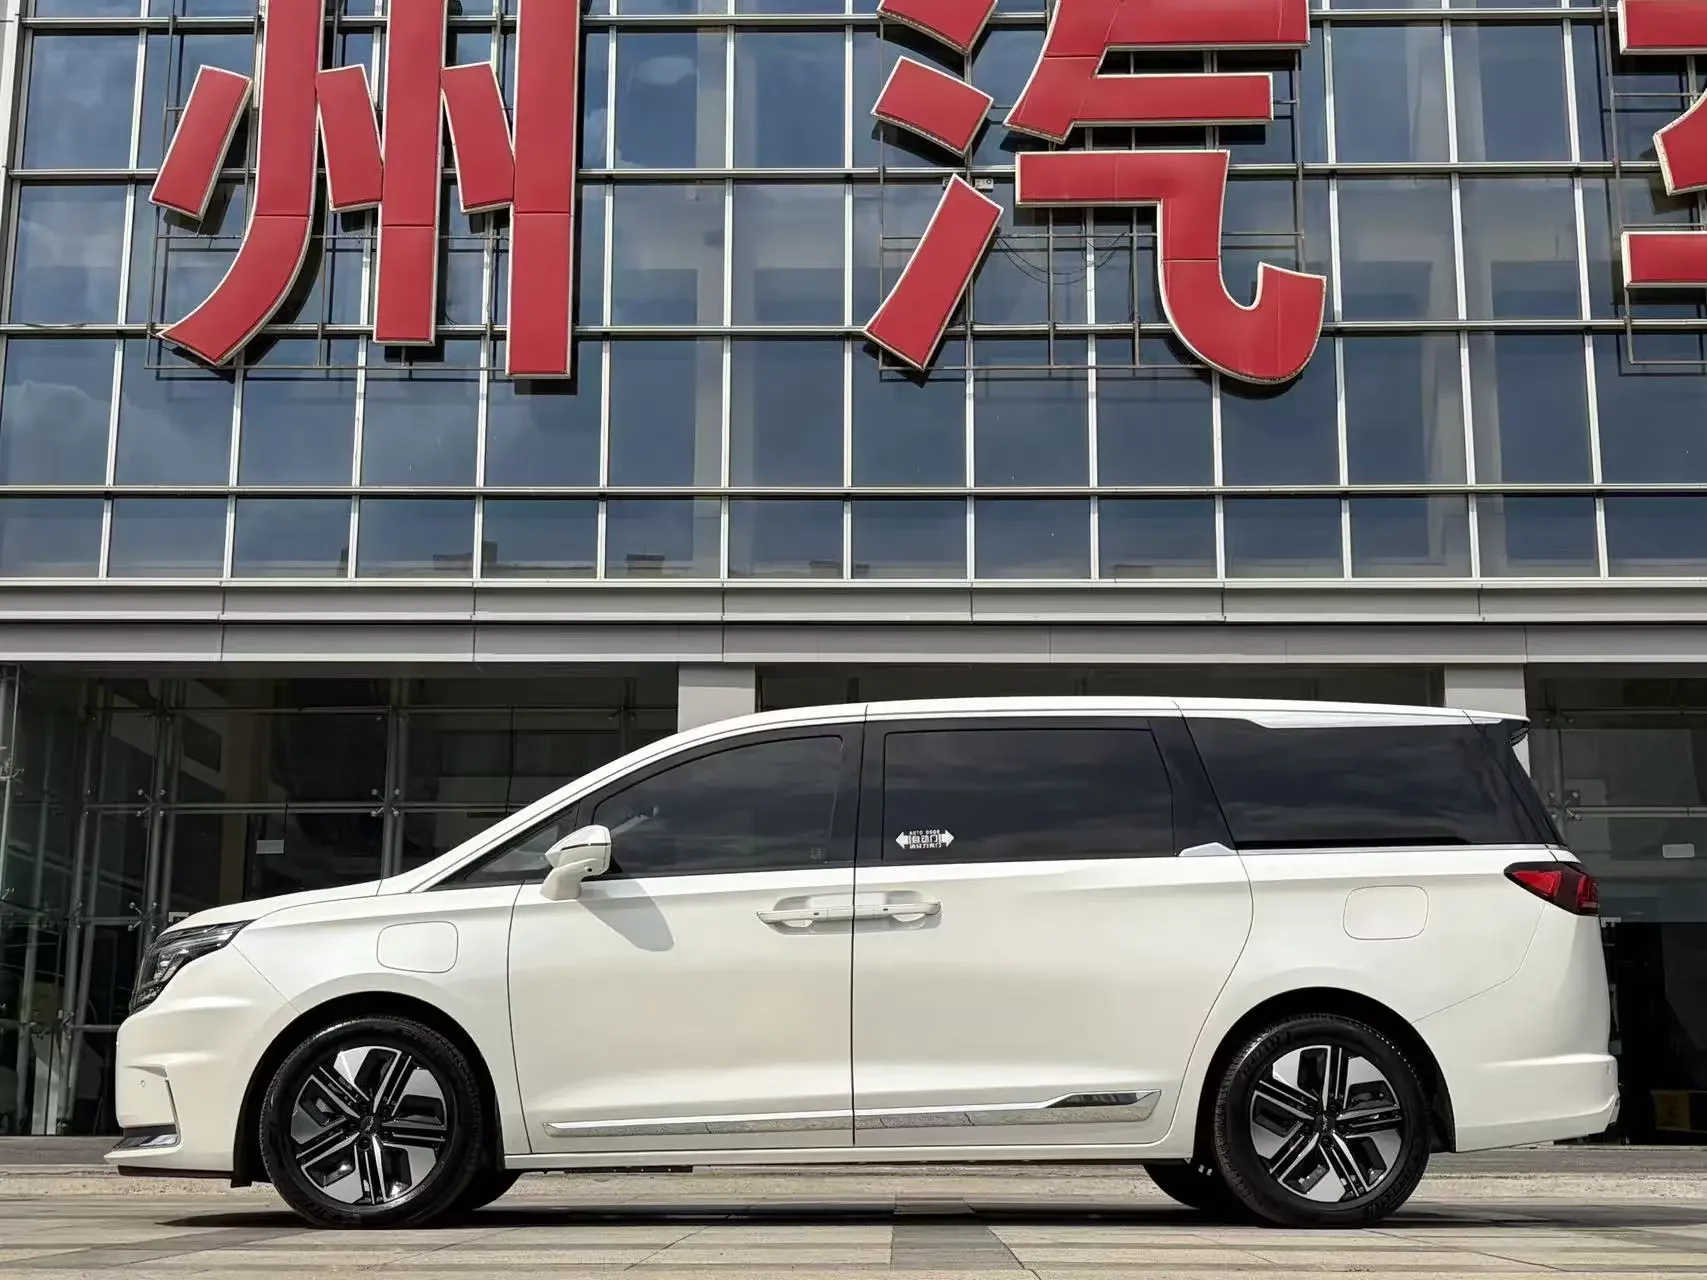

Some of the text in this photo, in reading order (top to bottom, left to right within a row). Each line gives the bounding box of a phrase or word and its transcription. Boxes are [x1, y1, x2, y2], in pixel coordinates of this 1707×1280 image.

[149, 0, 1707, 386] 州汽
[912, 835, 938, 843] 自动门
